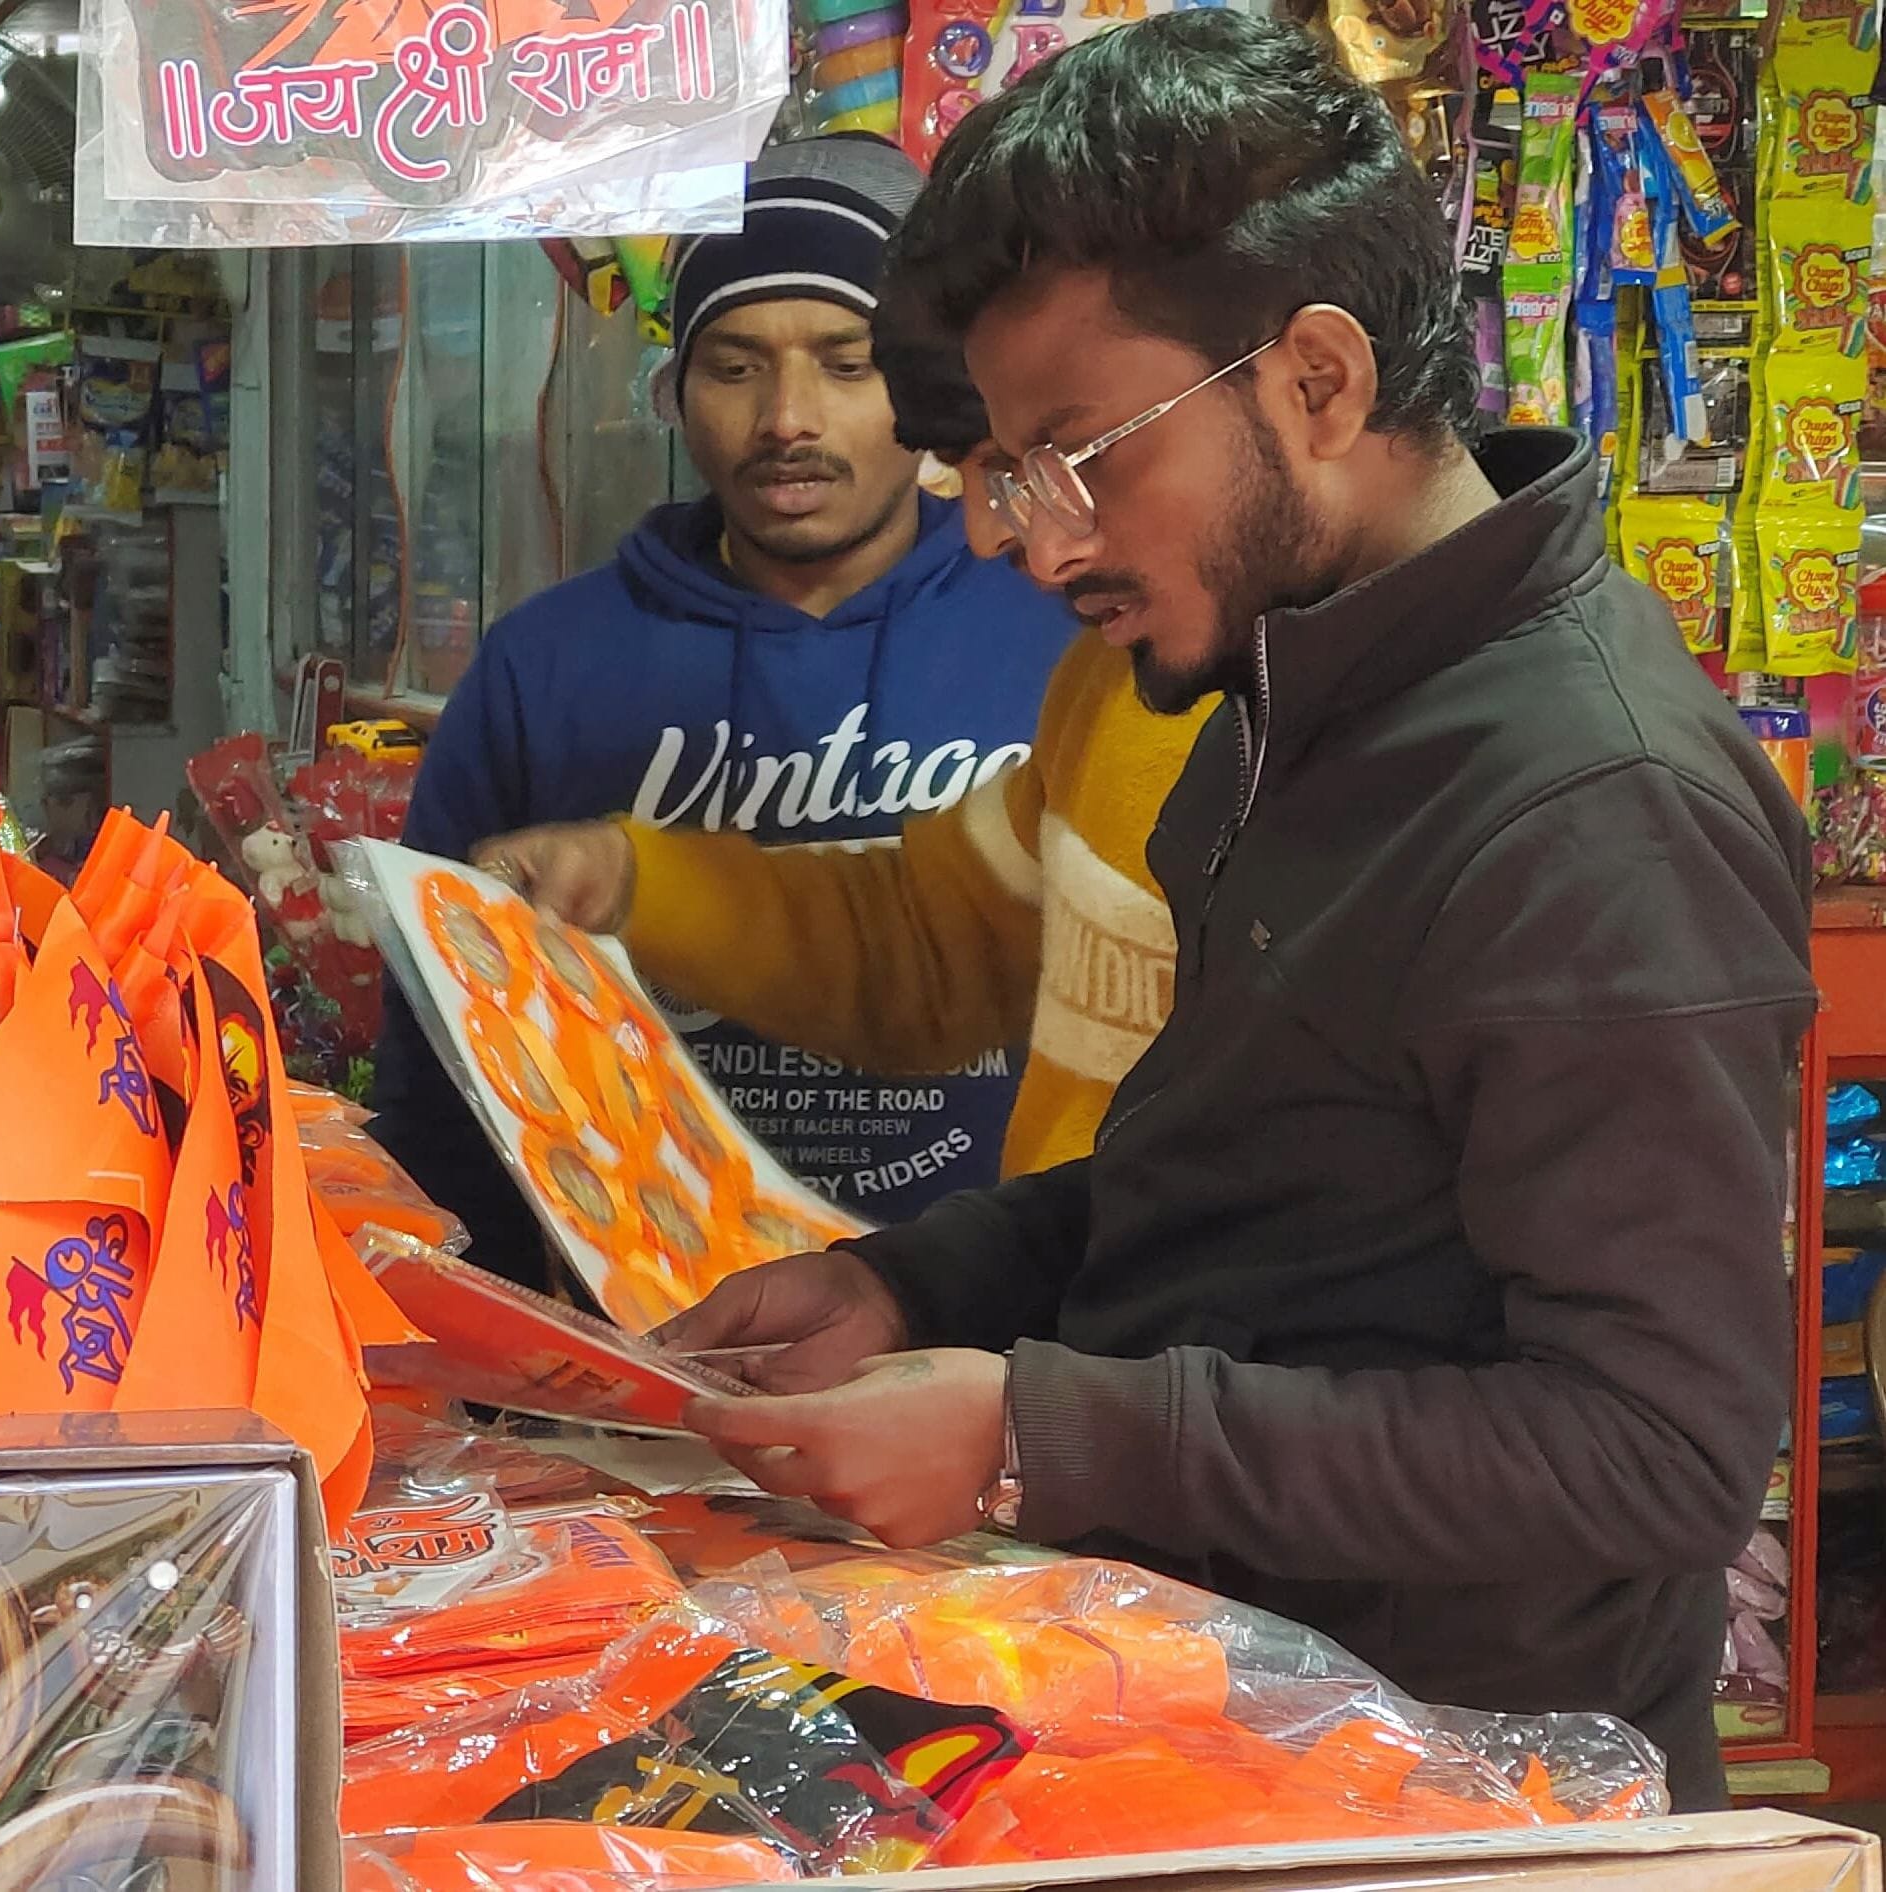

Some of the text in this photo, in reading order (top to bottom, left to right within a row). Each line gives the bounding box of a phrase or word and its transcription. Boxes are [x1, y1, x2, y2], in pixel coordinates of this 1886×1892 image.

[509, 22, 665, 118] राम
[785, 1088, 818, 1112] OF
[825, 1089, 872, 1112] THE
[878, 1089, 945, 1113] ROAD
[748, 1117, 789, 1136] TEST
[859, 1117, 912, 1137] CREW
[854, 1127, 975, 1198] RIDERS
